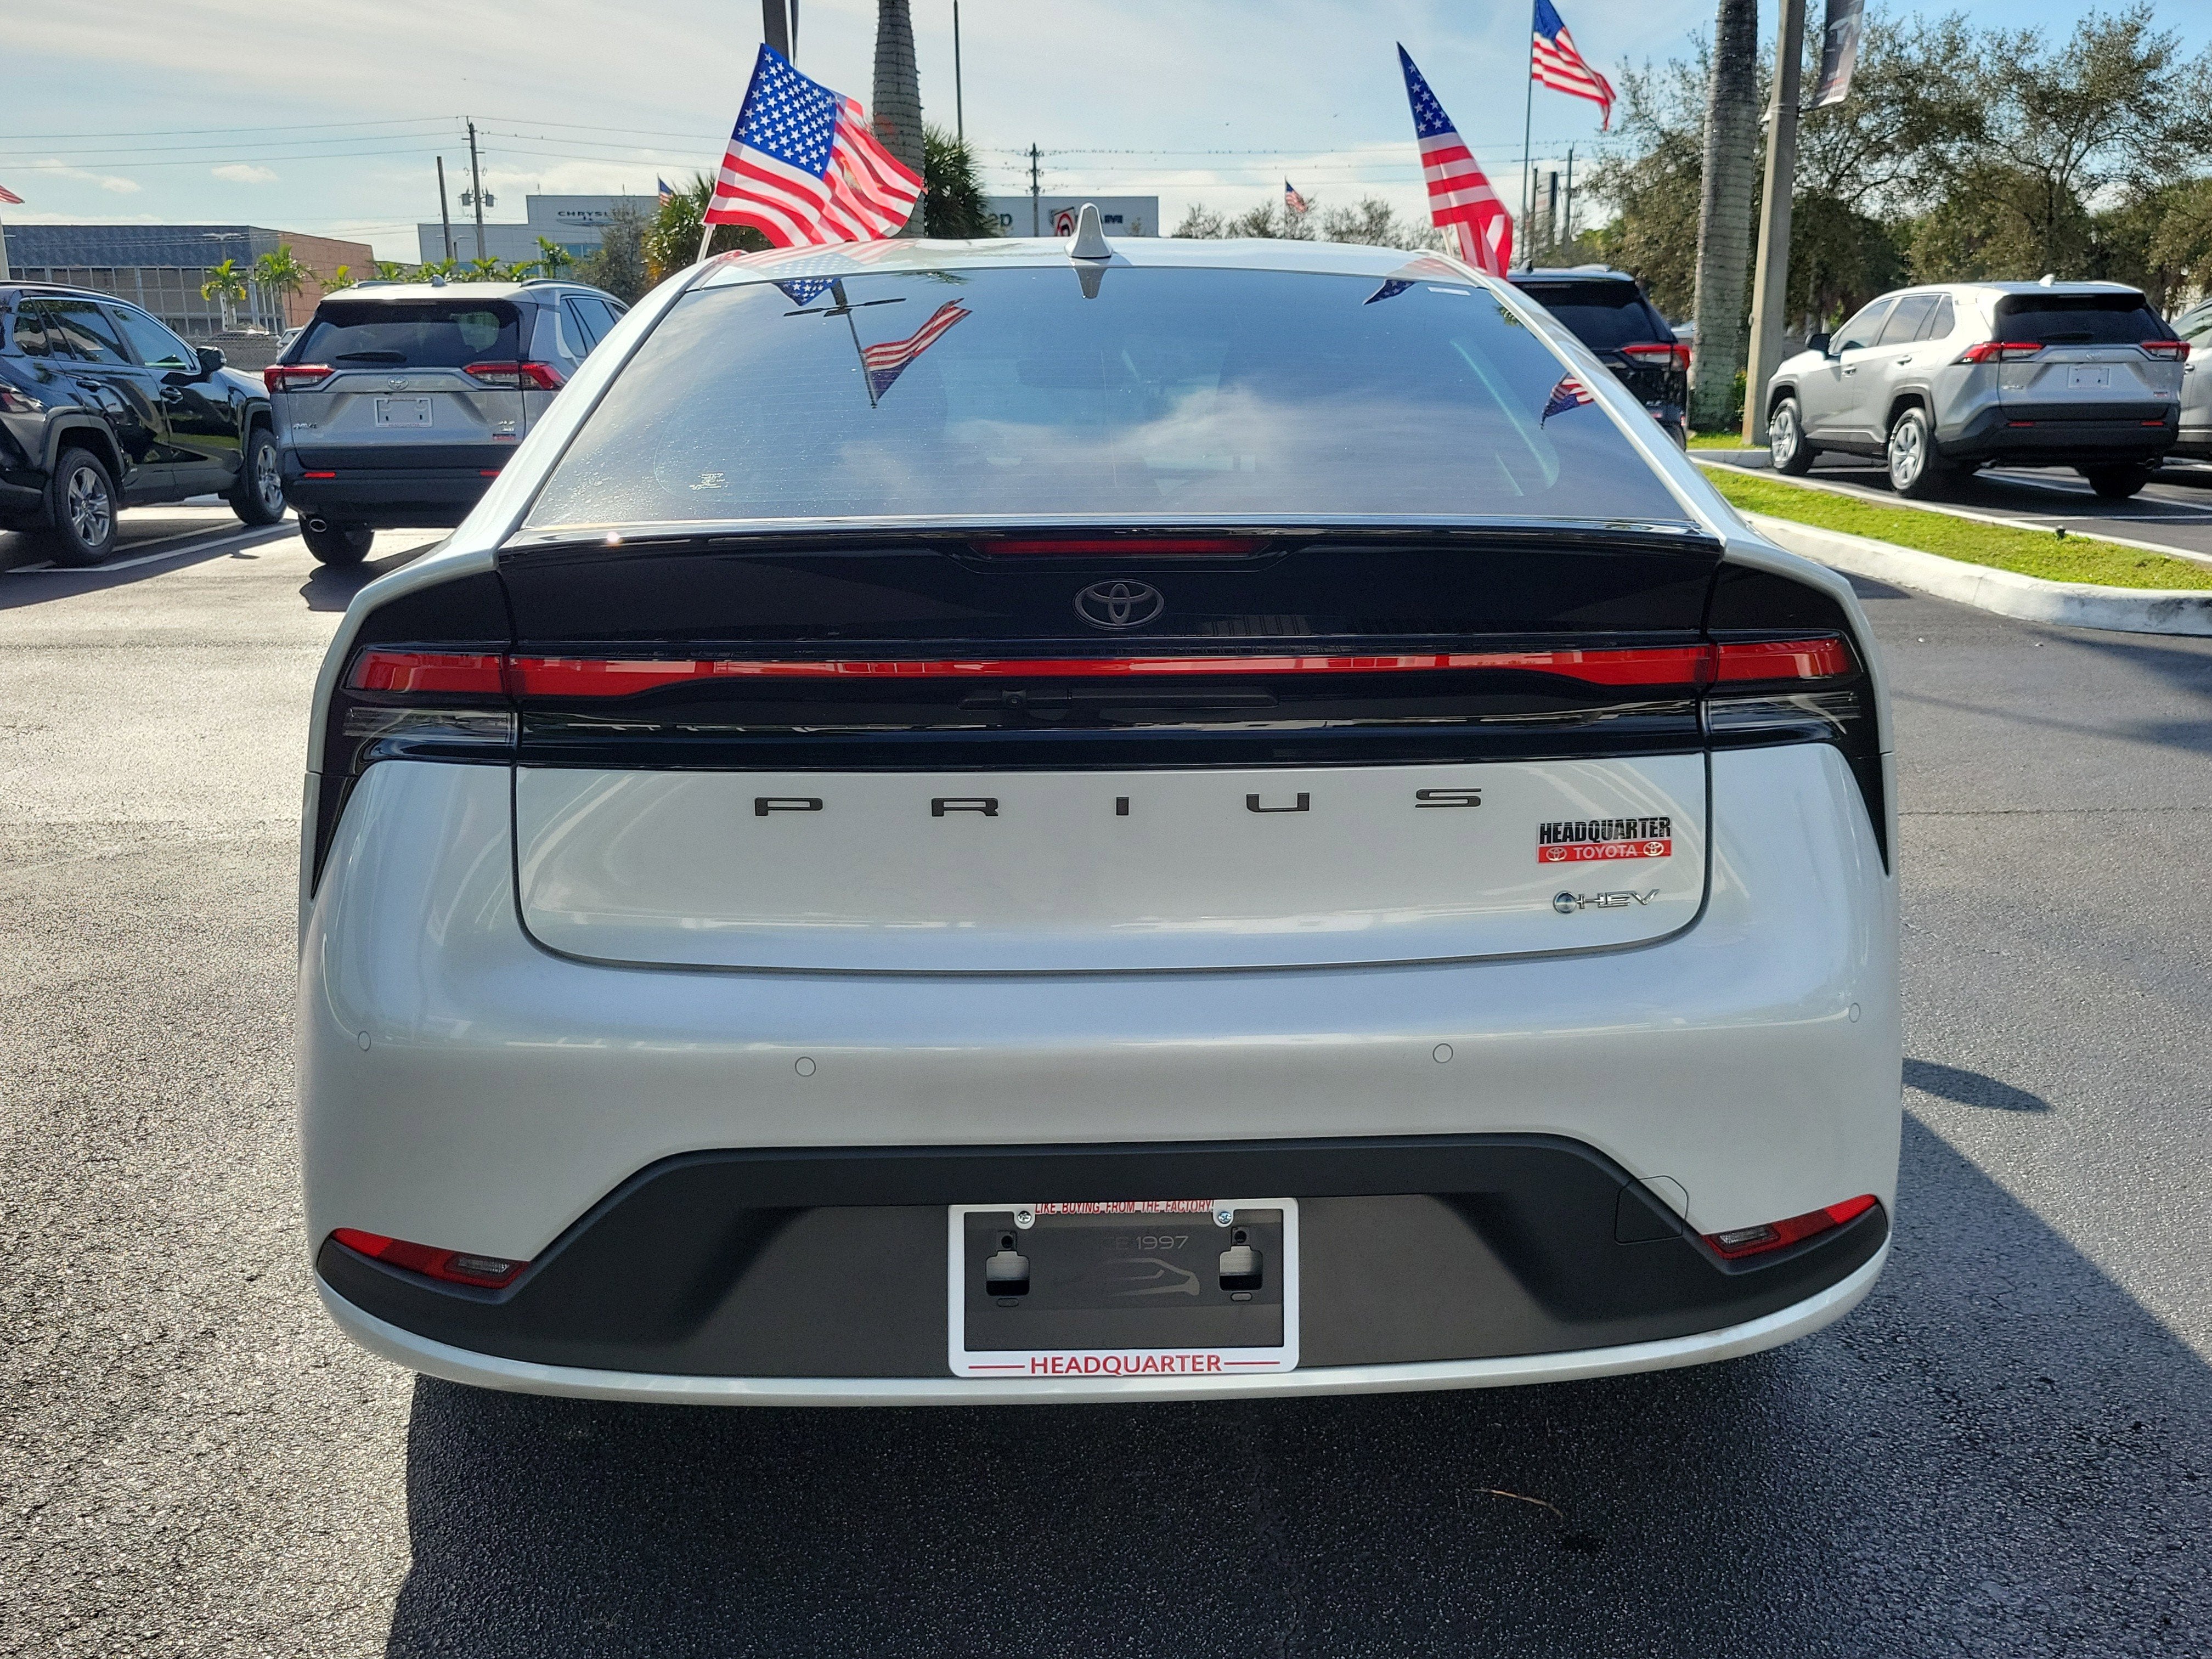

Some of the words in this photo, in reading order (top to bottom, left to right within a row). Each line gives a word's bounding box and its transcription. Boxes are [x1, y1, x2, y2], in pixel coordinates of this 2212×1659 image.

[755, 788, 1481, 817] PRIUS
[1539, 817, 1671, 844] HEADQUARTER
[1573, 844, 1638, 860] TOYOTA
[1035, 1203, 1057, 1214] LIKE
[1062, 1202, 1101, 1214] BUYING
[1105, 1201, 1135, 1213] FROM
[1141, 1200, 1160, 1212] THE
[1136, 1235, 1189, 1250] 1997
[1031, 1355, 1221, 1374] HEADQUARTER
